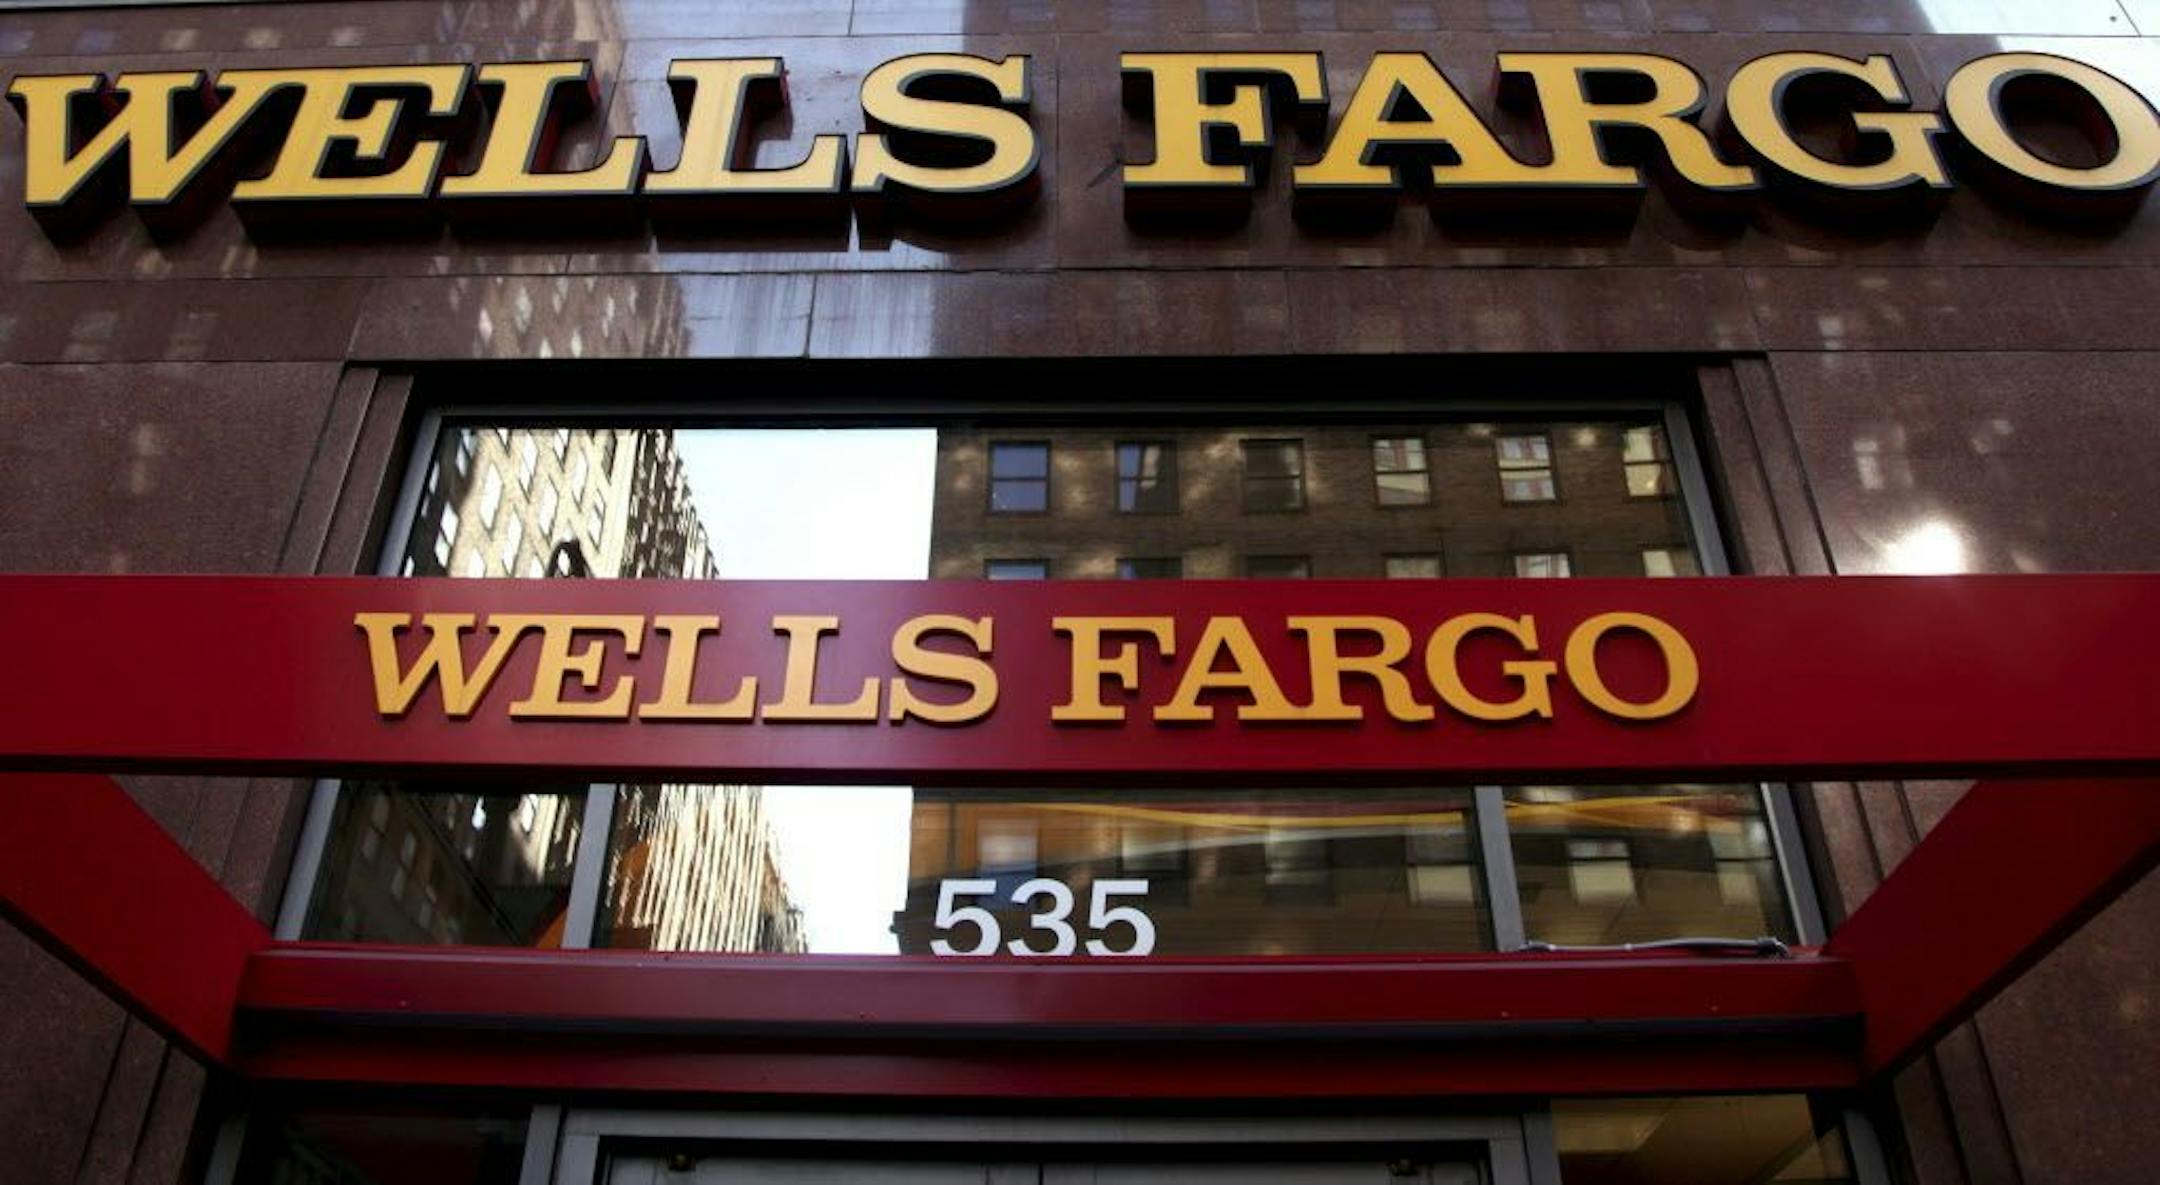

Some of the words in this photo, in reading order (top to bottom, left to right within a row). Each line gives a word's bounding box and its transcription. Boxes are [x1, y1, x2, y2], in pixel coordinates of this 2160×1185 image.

[8, 53, 1038, 206] WELLS
[1121, 52, 2160, 190] FARGO
[354, 612, 998, 724] WELLS
[1051, 612, 1699, 722] FARGO
[930, 878, 1156, 957] 535
